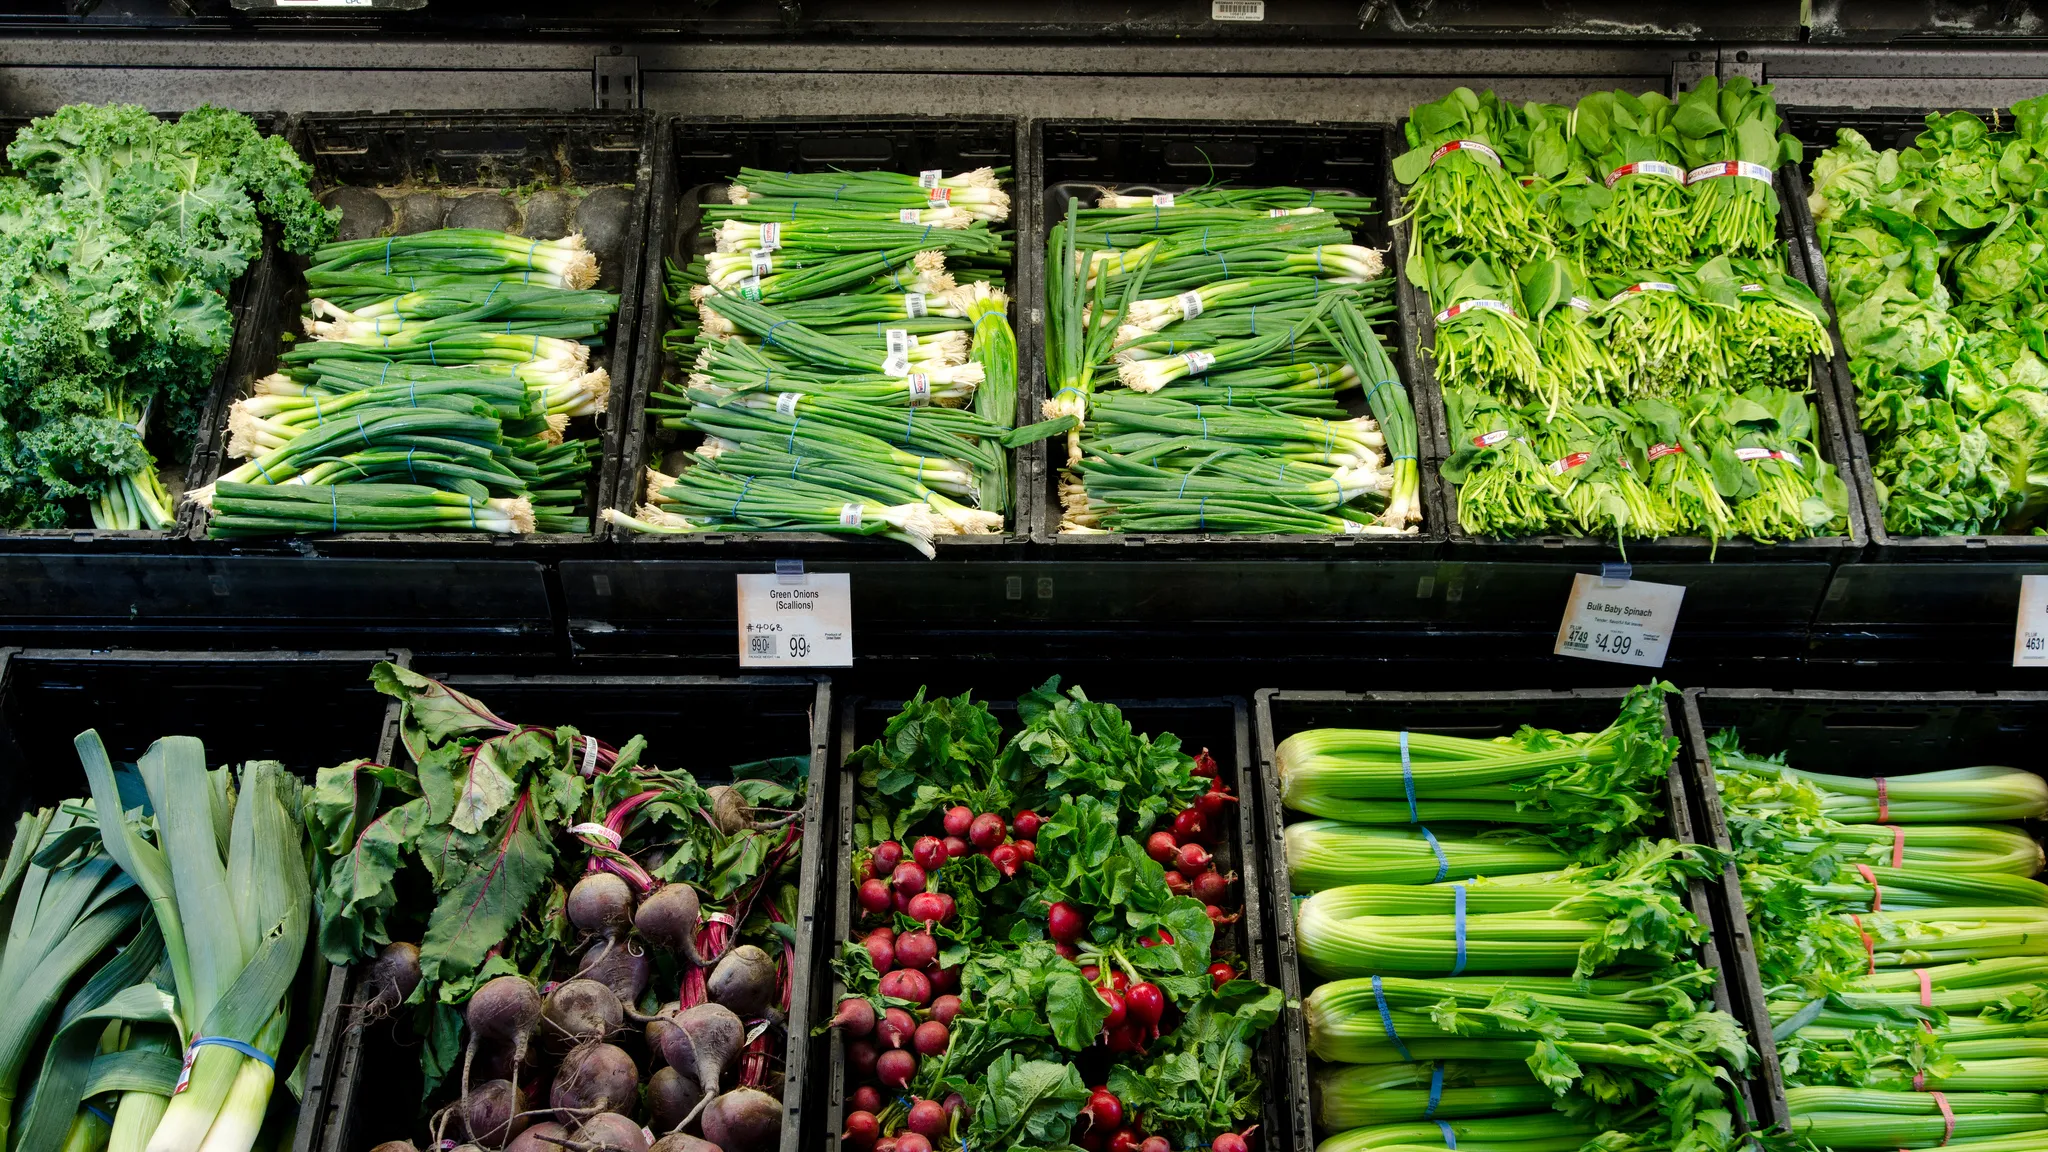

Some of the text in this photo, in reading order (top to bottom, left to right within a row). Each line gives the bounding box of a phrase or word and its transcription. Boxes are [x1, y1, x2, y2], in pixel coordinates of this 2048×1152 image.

[770, 589, 819, 599] Green Onions
[776, 600, 814, 611] (Scallions)
[1587, 602, 1653, 617] Bulk Baby Spinach
[1568, 630, 1589, 643] 4749
[789, 637, 811, 658] 99¢
[1595, 632, 1632, 655] $4.99
[1634, 648, 1645, 657] lb.
[2025, 637, 2045, 650] 4631
